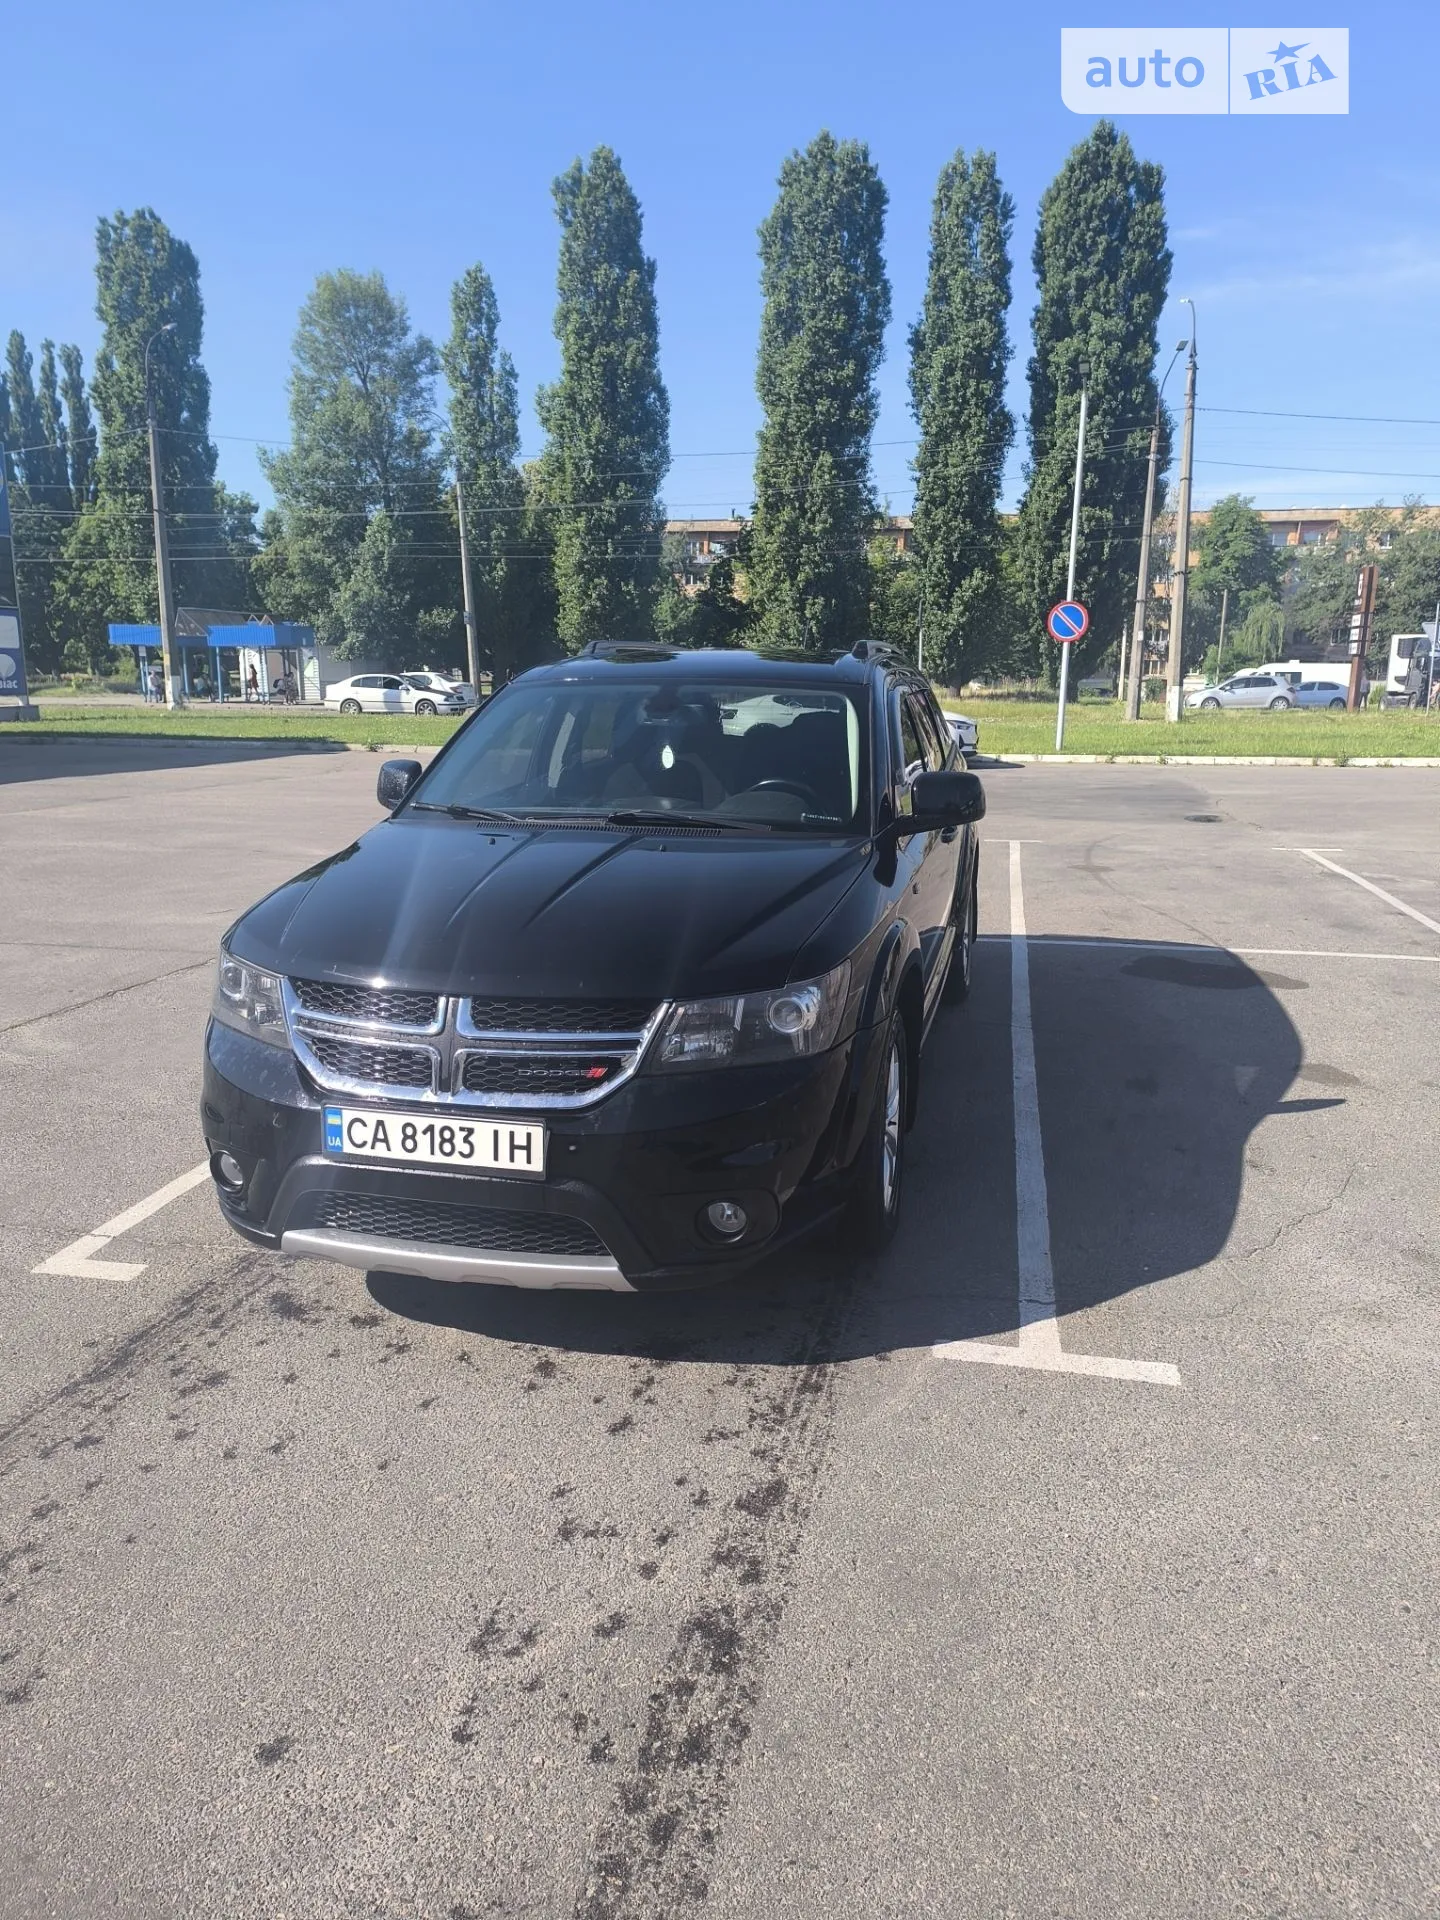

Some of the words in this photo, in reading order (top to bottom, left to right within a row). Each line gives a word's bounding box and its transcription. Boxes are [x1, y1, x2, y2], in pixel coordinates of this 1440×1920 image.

[518, 1068, 594, 1077] DODGE
[327, 1135, 343, 1148] UA
[346, 1117, 392, 1152] CA
[401, 1122, 475, 1159] 8183
[493, 1129, 532, 1164] IH
